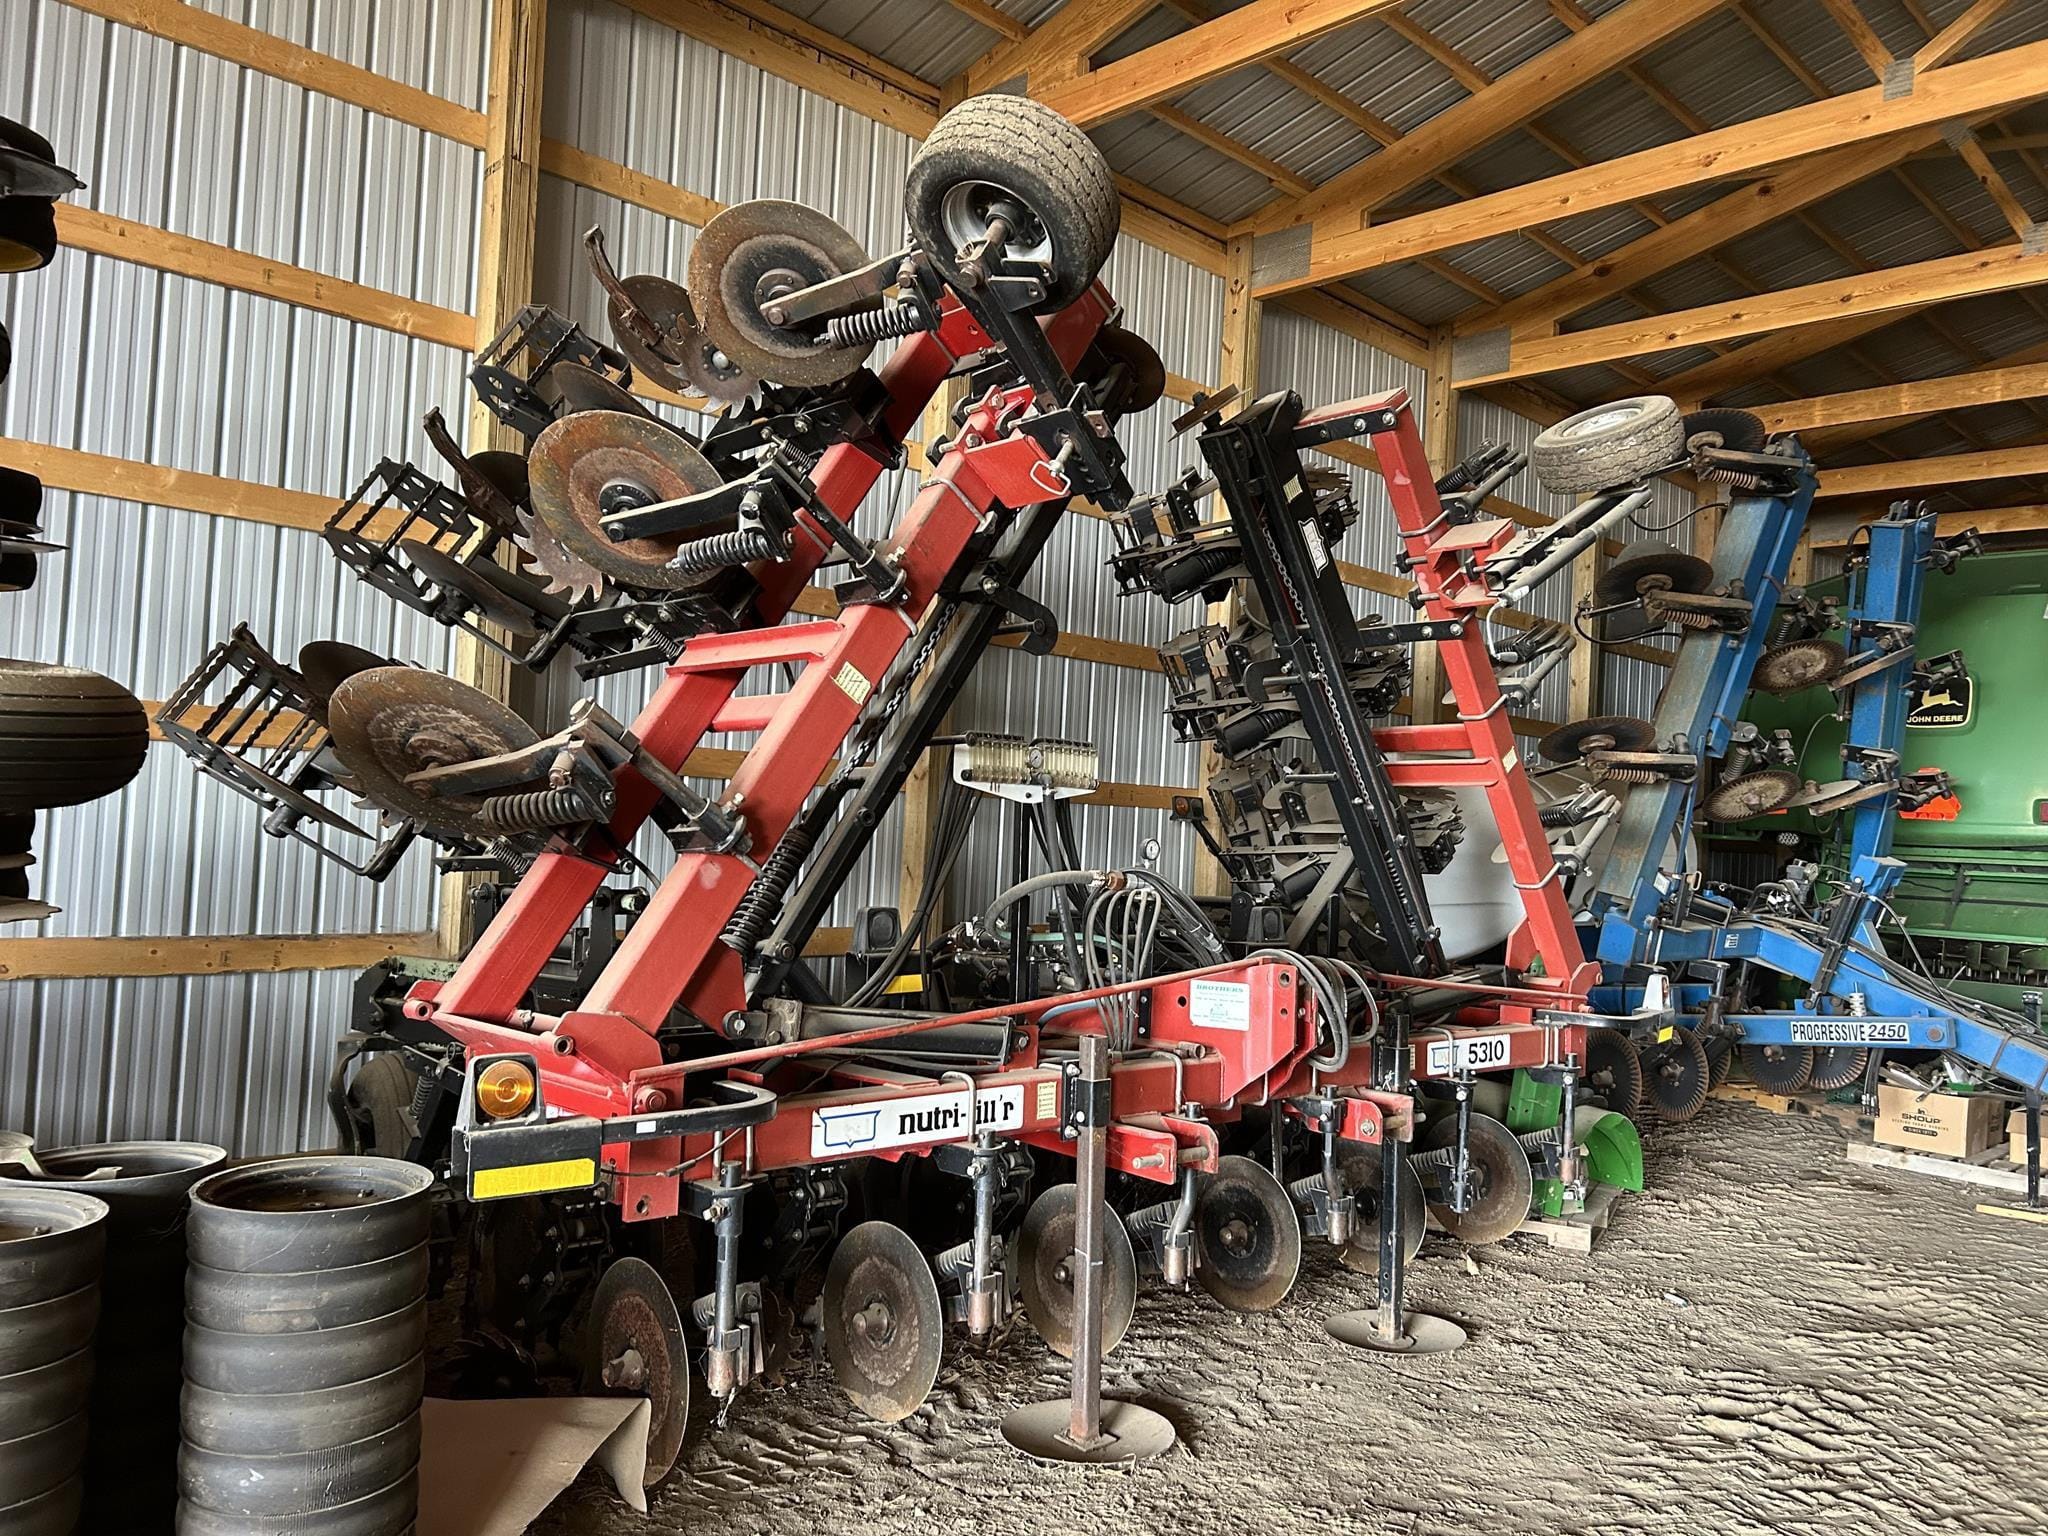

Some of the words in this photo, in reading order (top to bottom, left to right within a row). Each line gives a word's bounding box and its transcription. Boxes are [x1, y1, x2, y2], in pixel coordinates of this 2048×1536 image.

[1907, 715, 1931, 723] JOHN
[1933, 714, 1963, 722] DEERE
[1792, 1024, 1866, 1041] PROGRESSIVE
[1868, 1024, 1907, 1038] 2450
[1468, 1039, 1505, 1064] 5310
[898, 1094, 1014, 1136] nutri-ill'r
[1901, 1113, 1941, 1124] SHOUP
